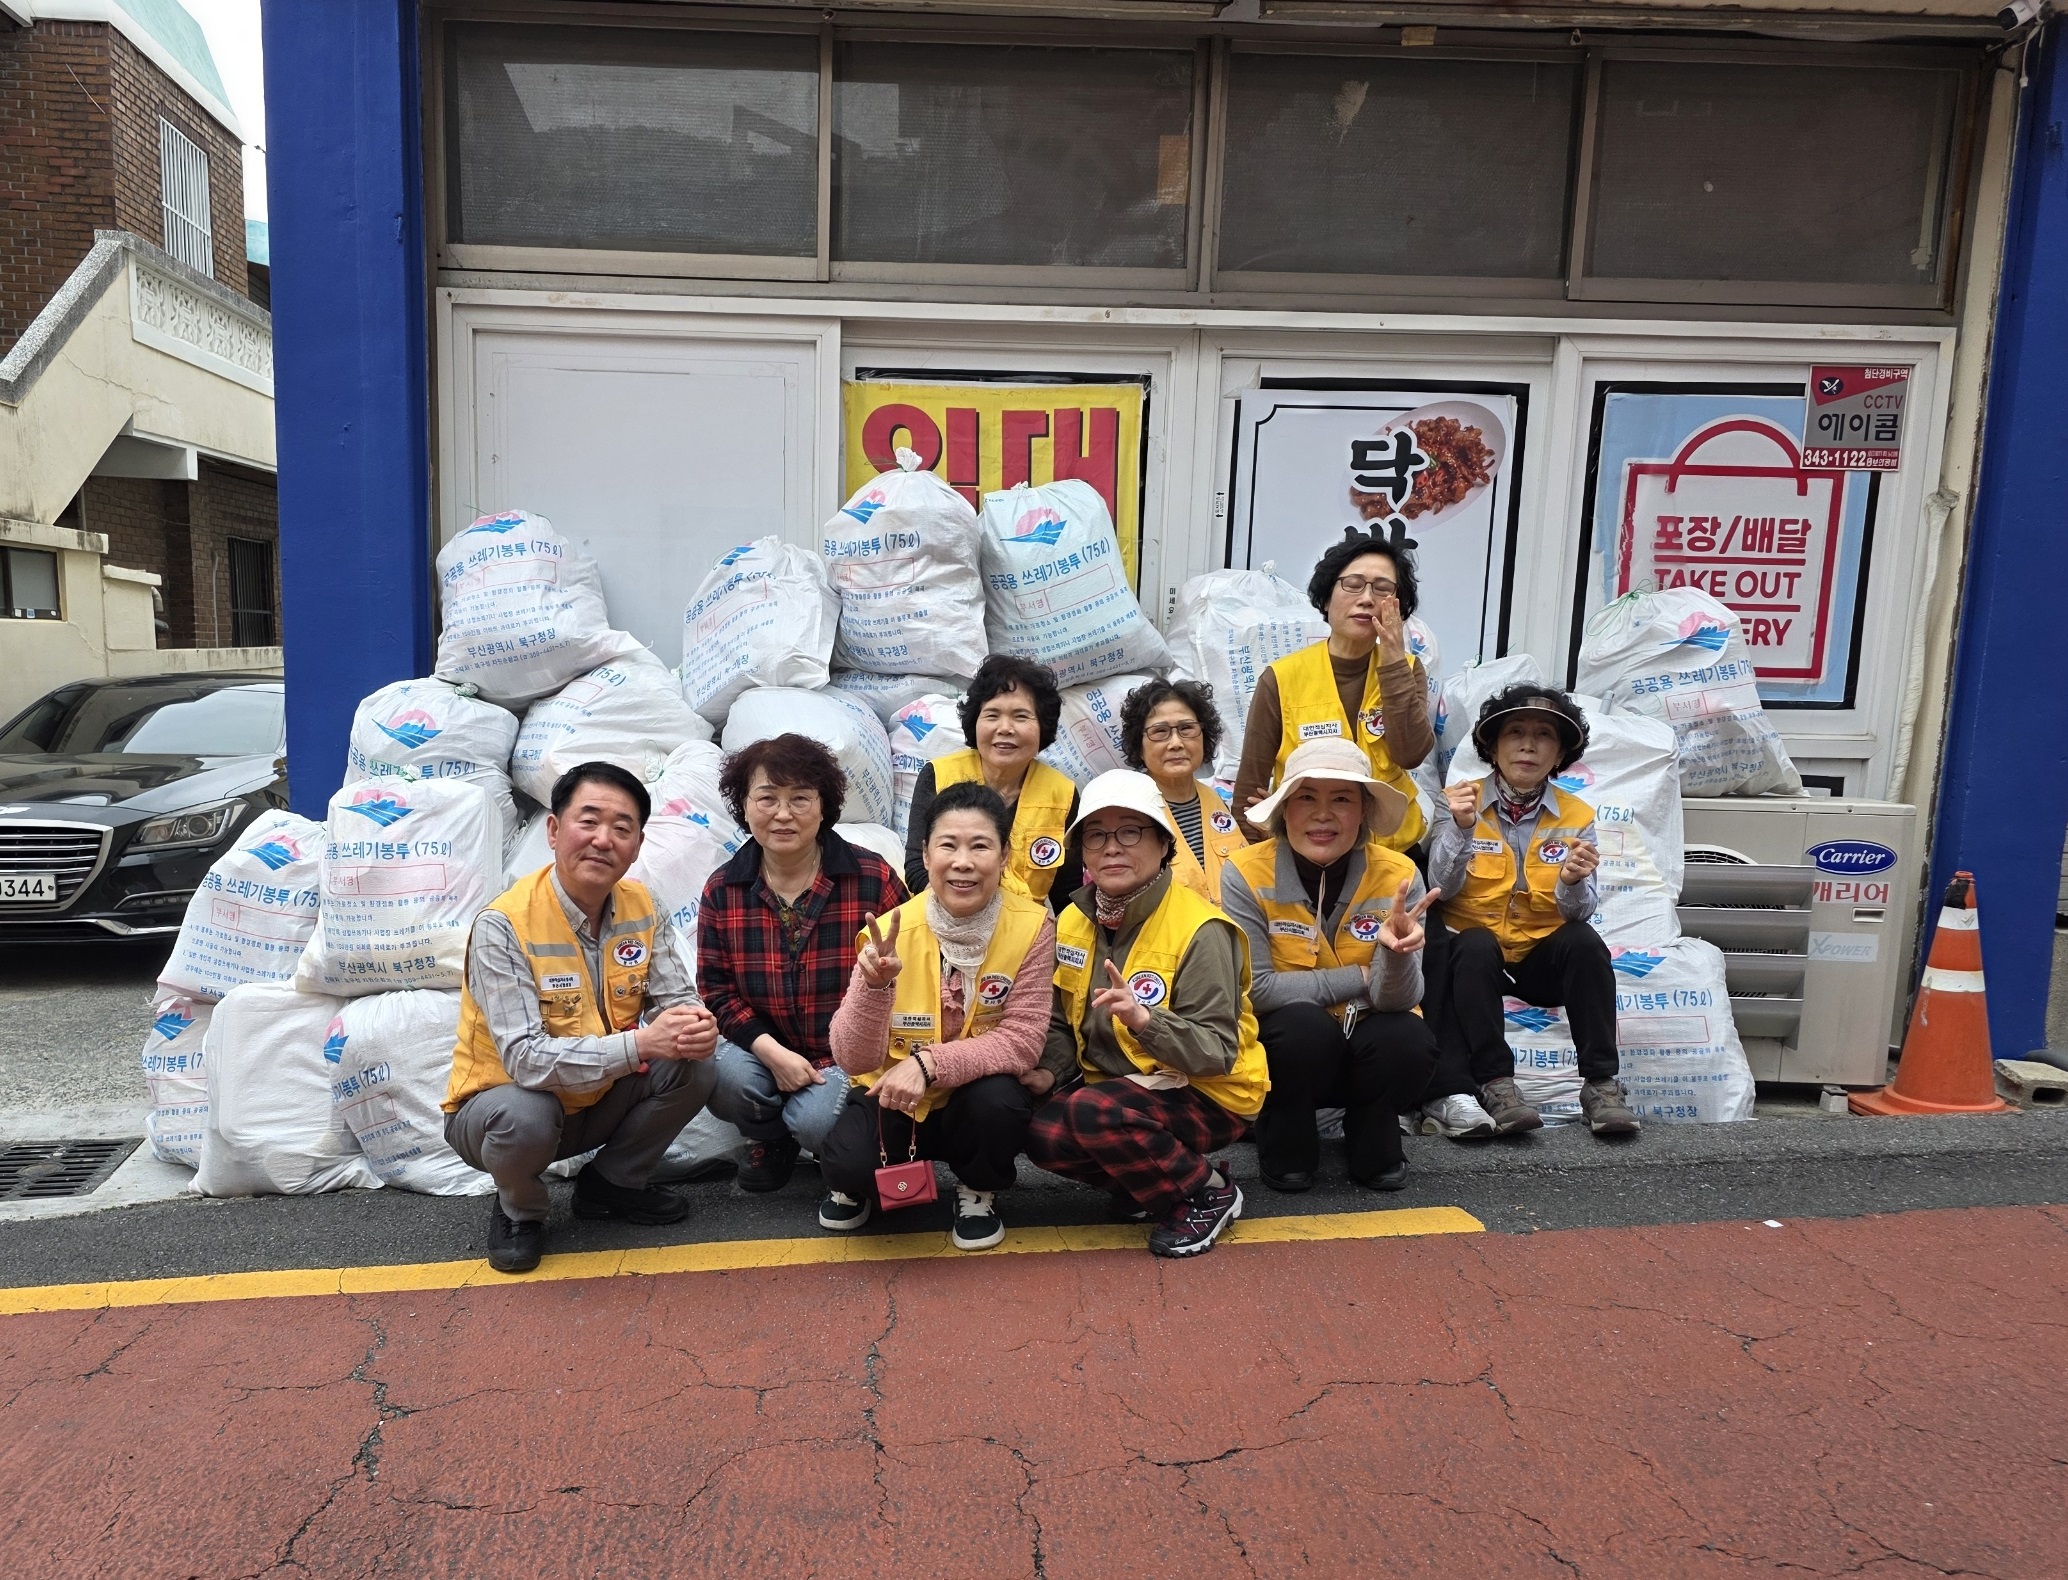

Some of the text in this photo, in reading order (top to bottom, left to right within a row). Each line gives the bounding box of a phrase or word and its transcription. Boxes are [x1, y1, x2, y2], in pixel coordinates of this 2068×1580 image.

[1864, 367, 1909, 380] 첨단경비구역
[1863, 394, 1904, 409] CCTV
[1818, 413, 1899, 442] 에이콤
[1804, 449, 1867, 467] 343-1122
[884, 530, 921, 552] (75ℓ)
[1653, 515, 1812, 555] 포장/배달
[468, 542, 527, 569] 쓰레기봉투
[989, 536, 1111, 591] 공공용 쓰레기봉투 (75ℓ)
[1653, 568, 1802, 599] TAKE OUT
[467, 627, 556, 658] 부산광역시 북구청장
[877, 644, 909, 657] 북구청장
[1053, 647, 1125, 680] 광역시 북구청장
[1238, 645, 1256, 694] 부산광역시
[1631, 674, 1674, 695] 공공용
[1678, 663, 1738, 687] 쓰레기봉투
[1086, 688, 1112, 723] 공공용
[1596, 804, 1635, 825] (75ℓ)
[341, 841, 411, 860] 쓰레기봉투
[414, 840, 453, 858] (75ℓ)
[1819, 848, 1886, 865] Carrier
[0, 879, 45, 897] 344
[226, 877, 291, 906] 쓰레기봉투
[293, 889, 321, 909] (75
[338, 955, 436, 974] 부산광역시 북구청장
[1673, 988, 1713, 1008] (75ℓ)
[1562, 1048, 1578, 1068] (75
[358, 1061, 391, 1089] (75ℓ)
[1652, 1105, 1697, 1118] 북구청장
